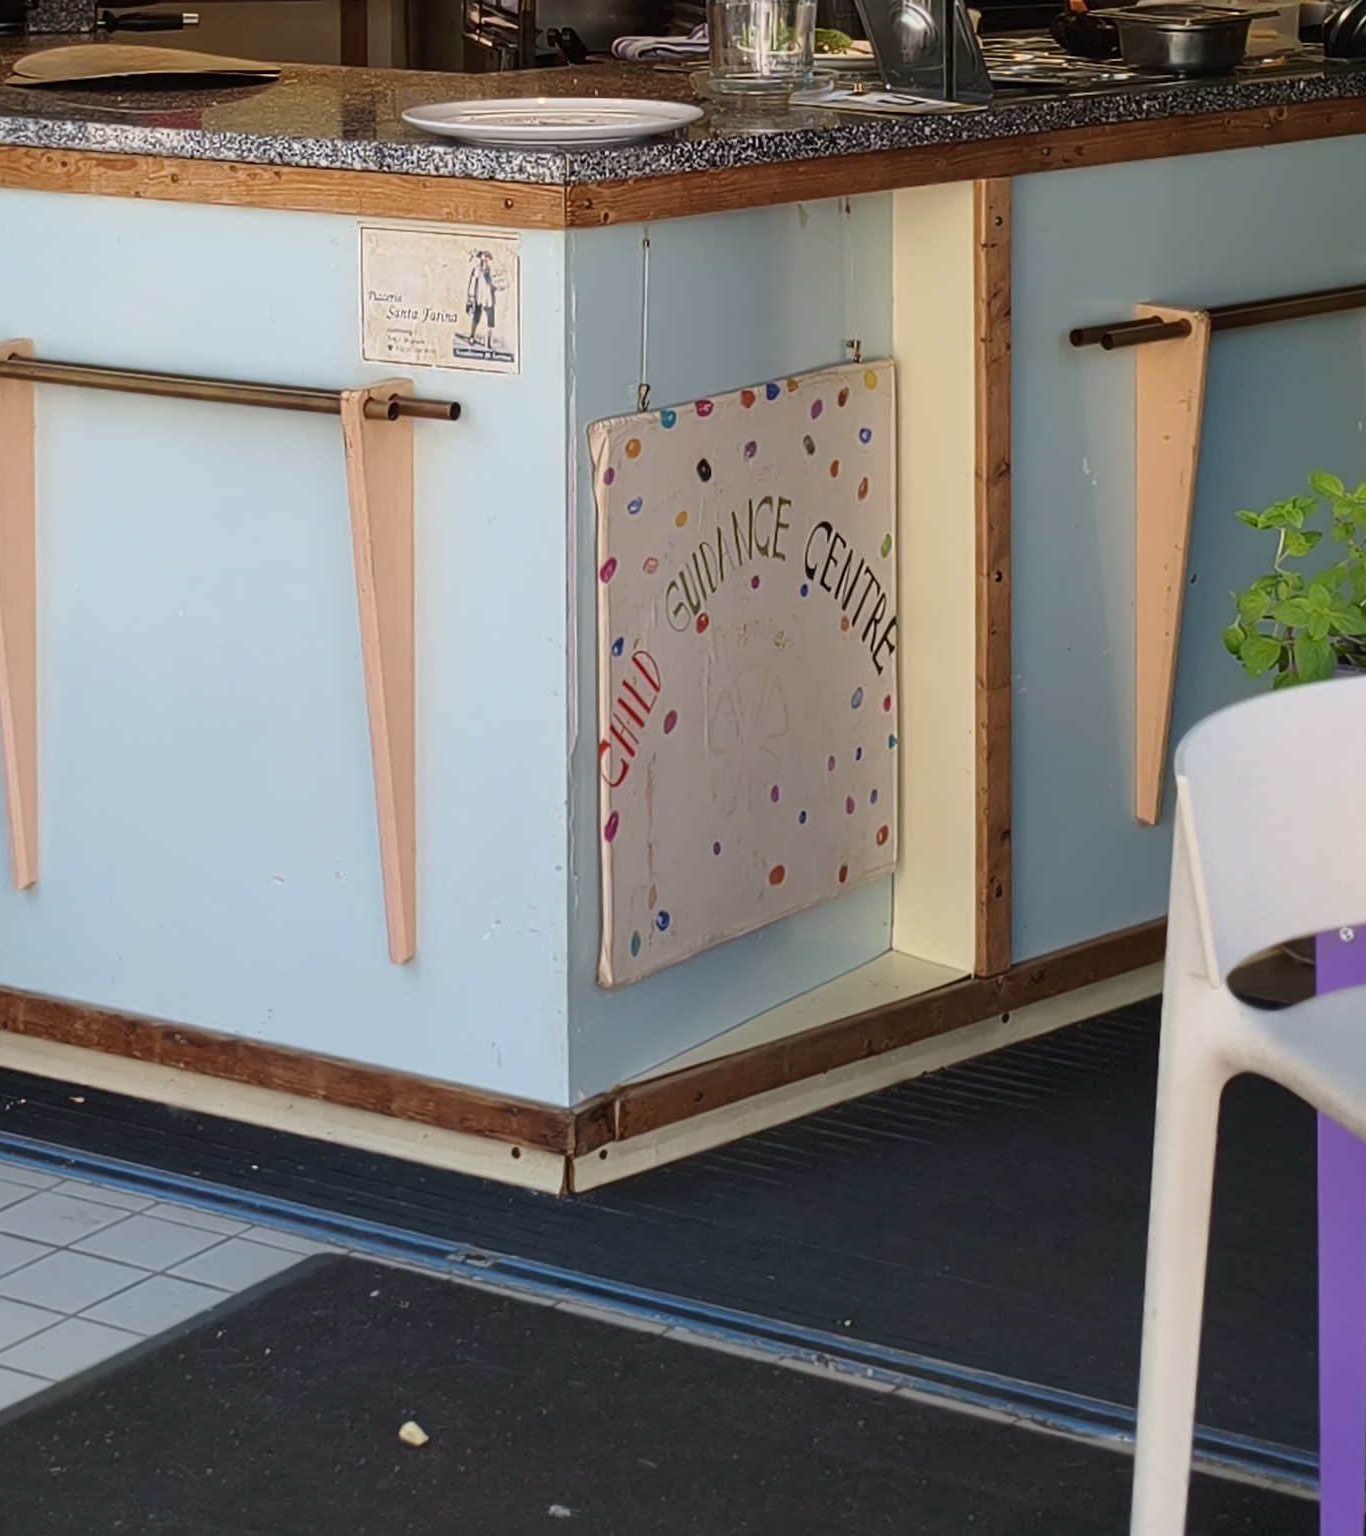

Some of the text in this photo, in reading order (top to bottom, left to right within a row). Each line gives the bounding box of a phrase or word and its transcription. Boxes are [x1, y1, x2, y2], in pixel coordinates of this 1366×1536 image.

[386, 306, 419, 320] Santa
[598, 494, 899, 788] CHILD GUIDANCE CENTRE
